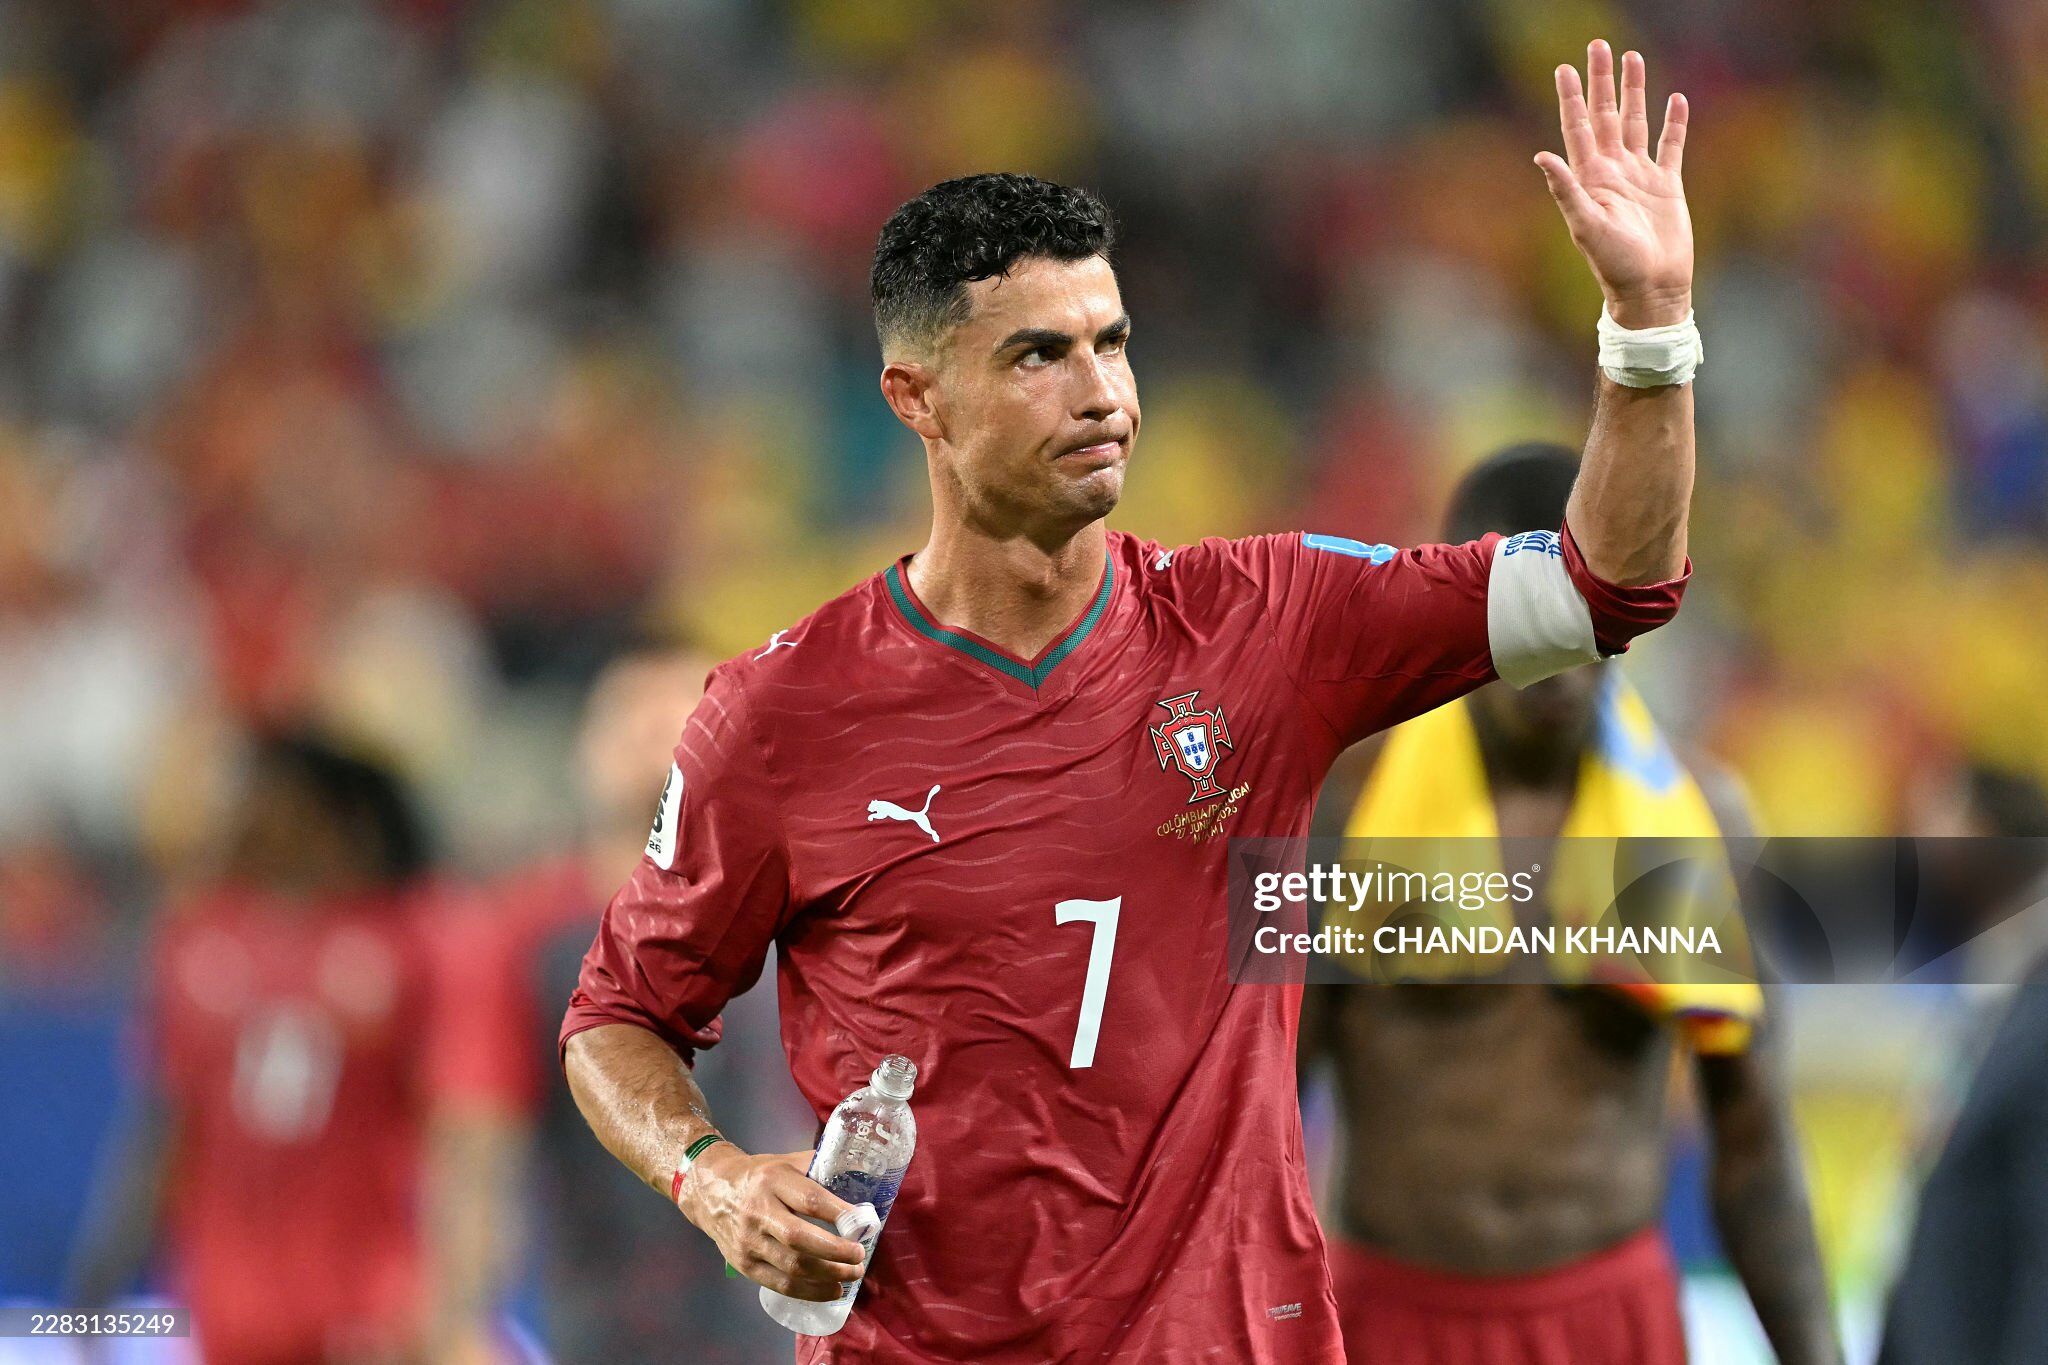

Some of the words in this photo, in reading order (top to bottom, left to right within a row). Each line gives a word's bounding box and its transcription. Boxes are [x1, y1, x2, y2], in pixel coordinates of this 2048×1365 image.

[1175, 828, 1187, 840] 27
[1216, 805, 1238, 822] 2026
[1055, 895, 1122, 1069] 7
